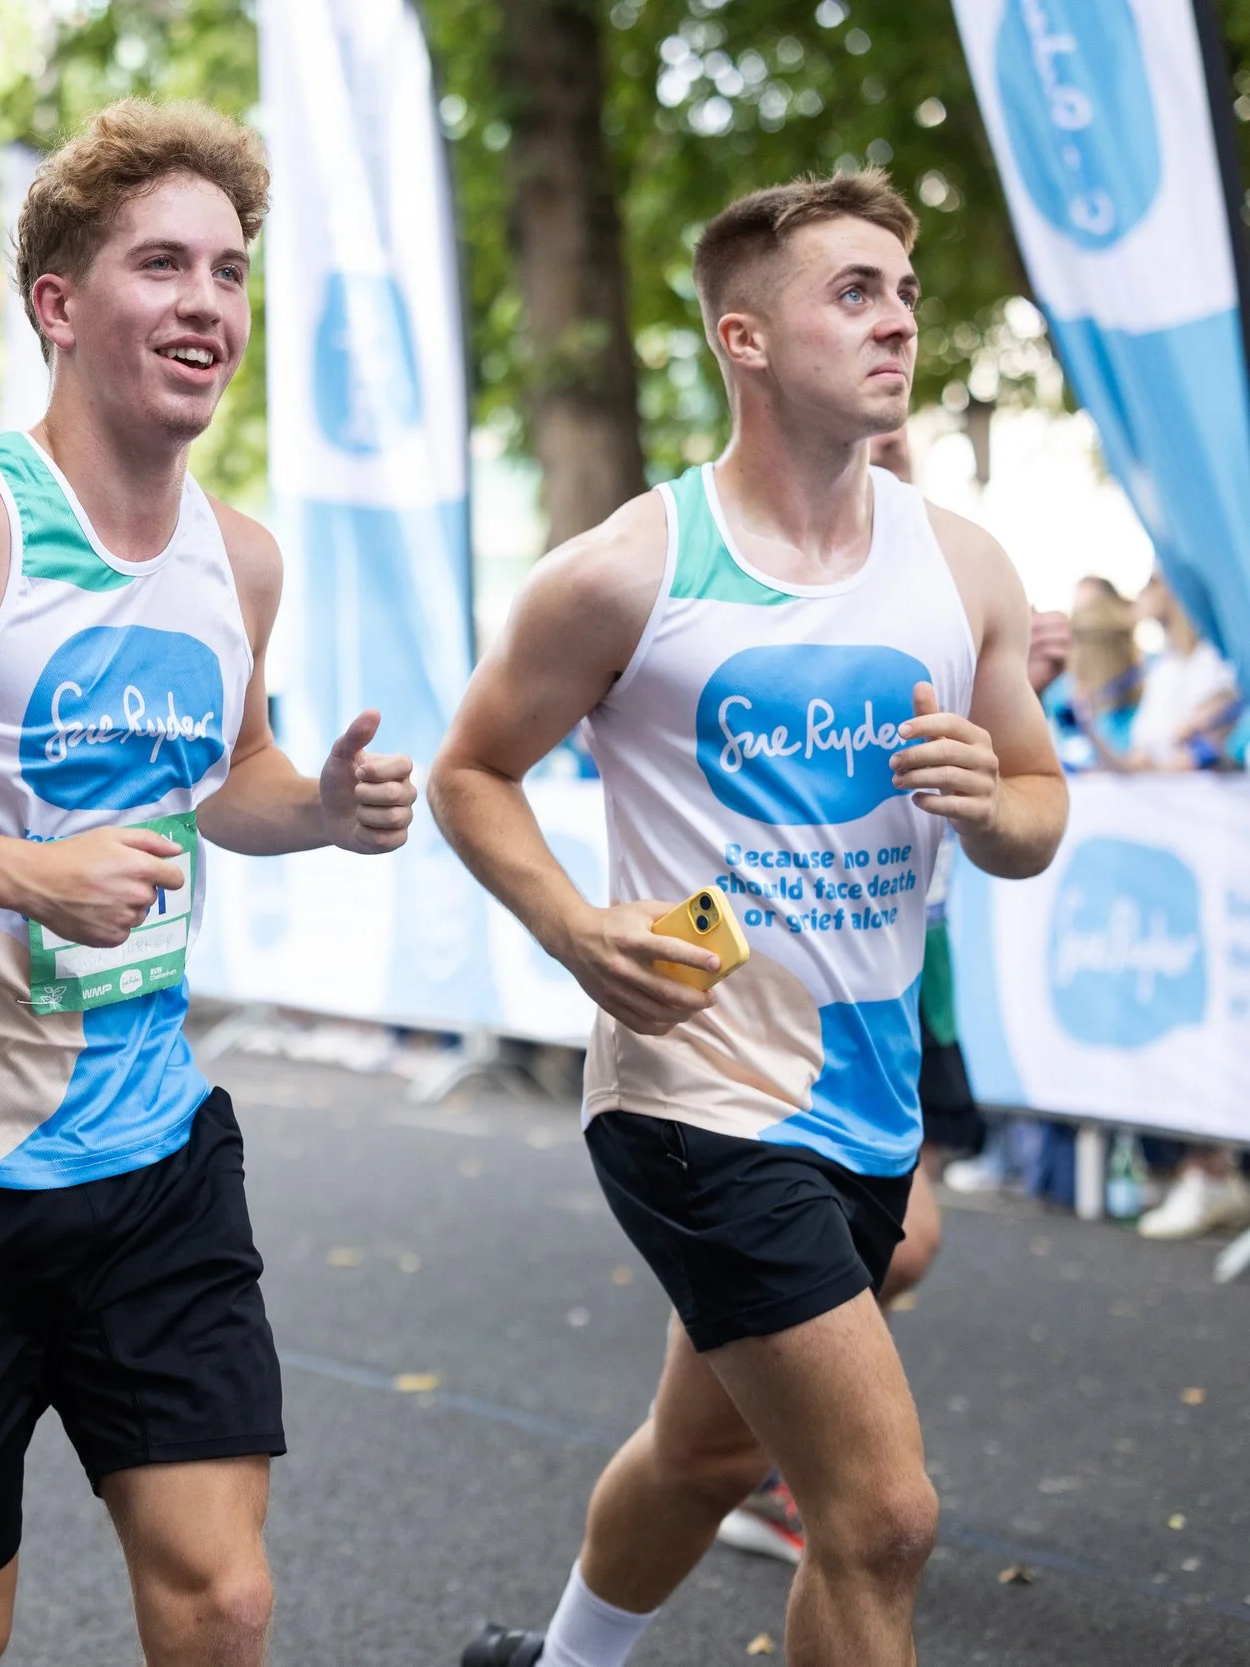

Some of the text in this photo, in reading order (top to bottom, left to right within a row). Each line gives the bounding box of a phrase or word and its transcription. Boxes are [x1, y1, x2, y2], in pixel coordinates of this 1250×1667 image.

[44, 681, 215, 763] Sue Ryder
[717, 695, 802, 773] Sue
[724, 842, 912, 869] Because no one
[715, 871, 917, 901] should face death
[743, 905, 899, 934] or grief alone
[82, 983, 113, 1000] WMP
